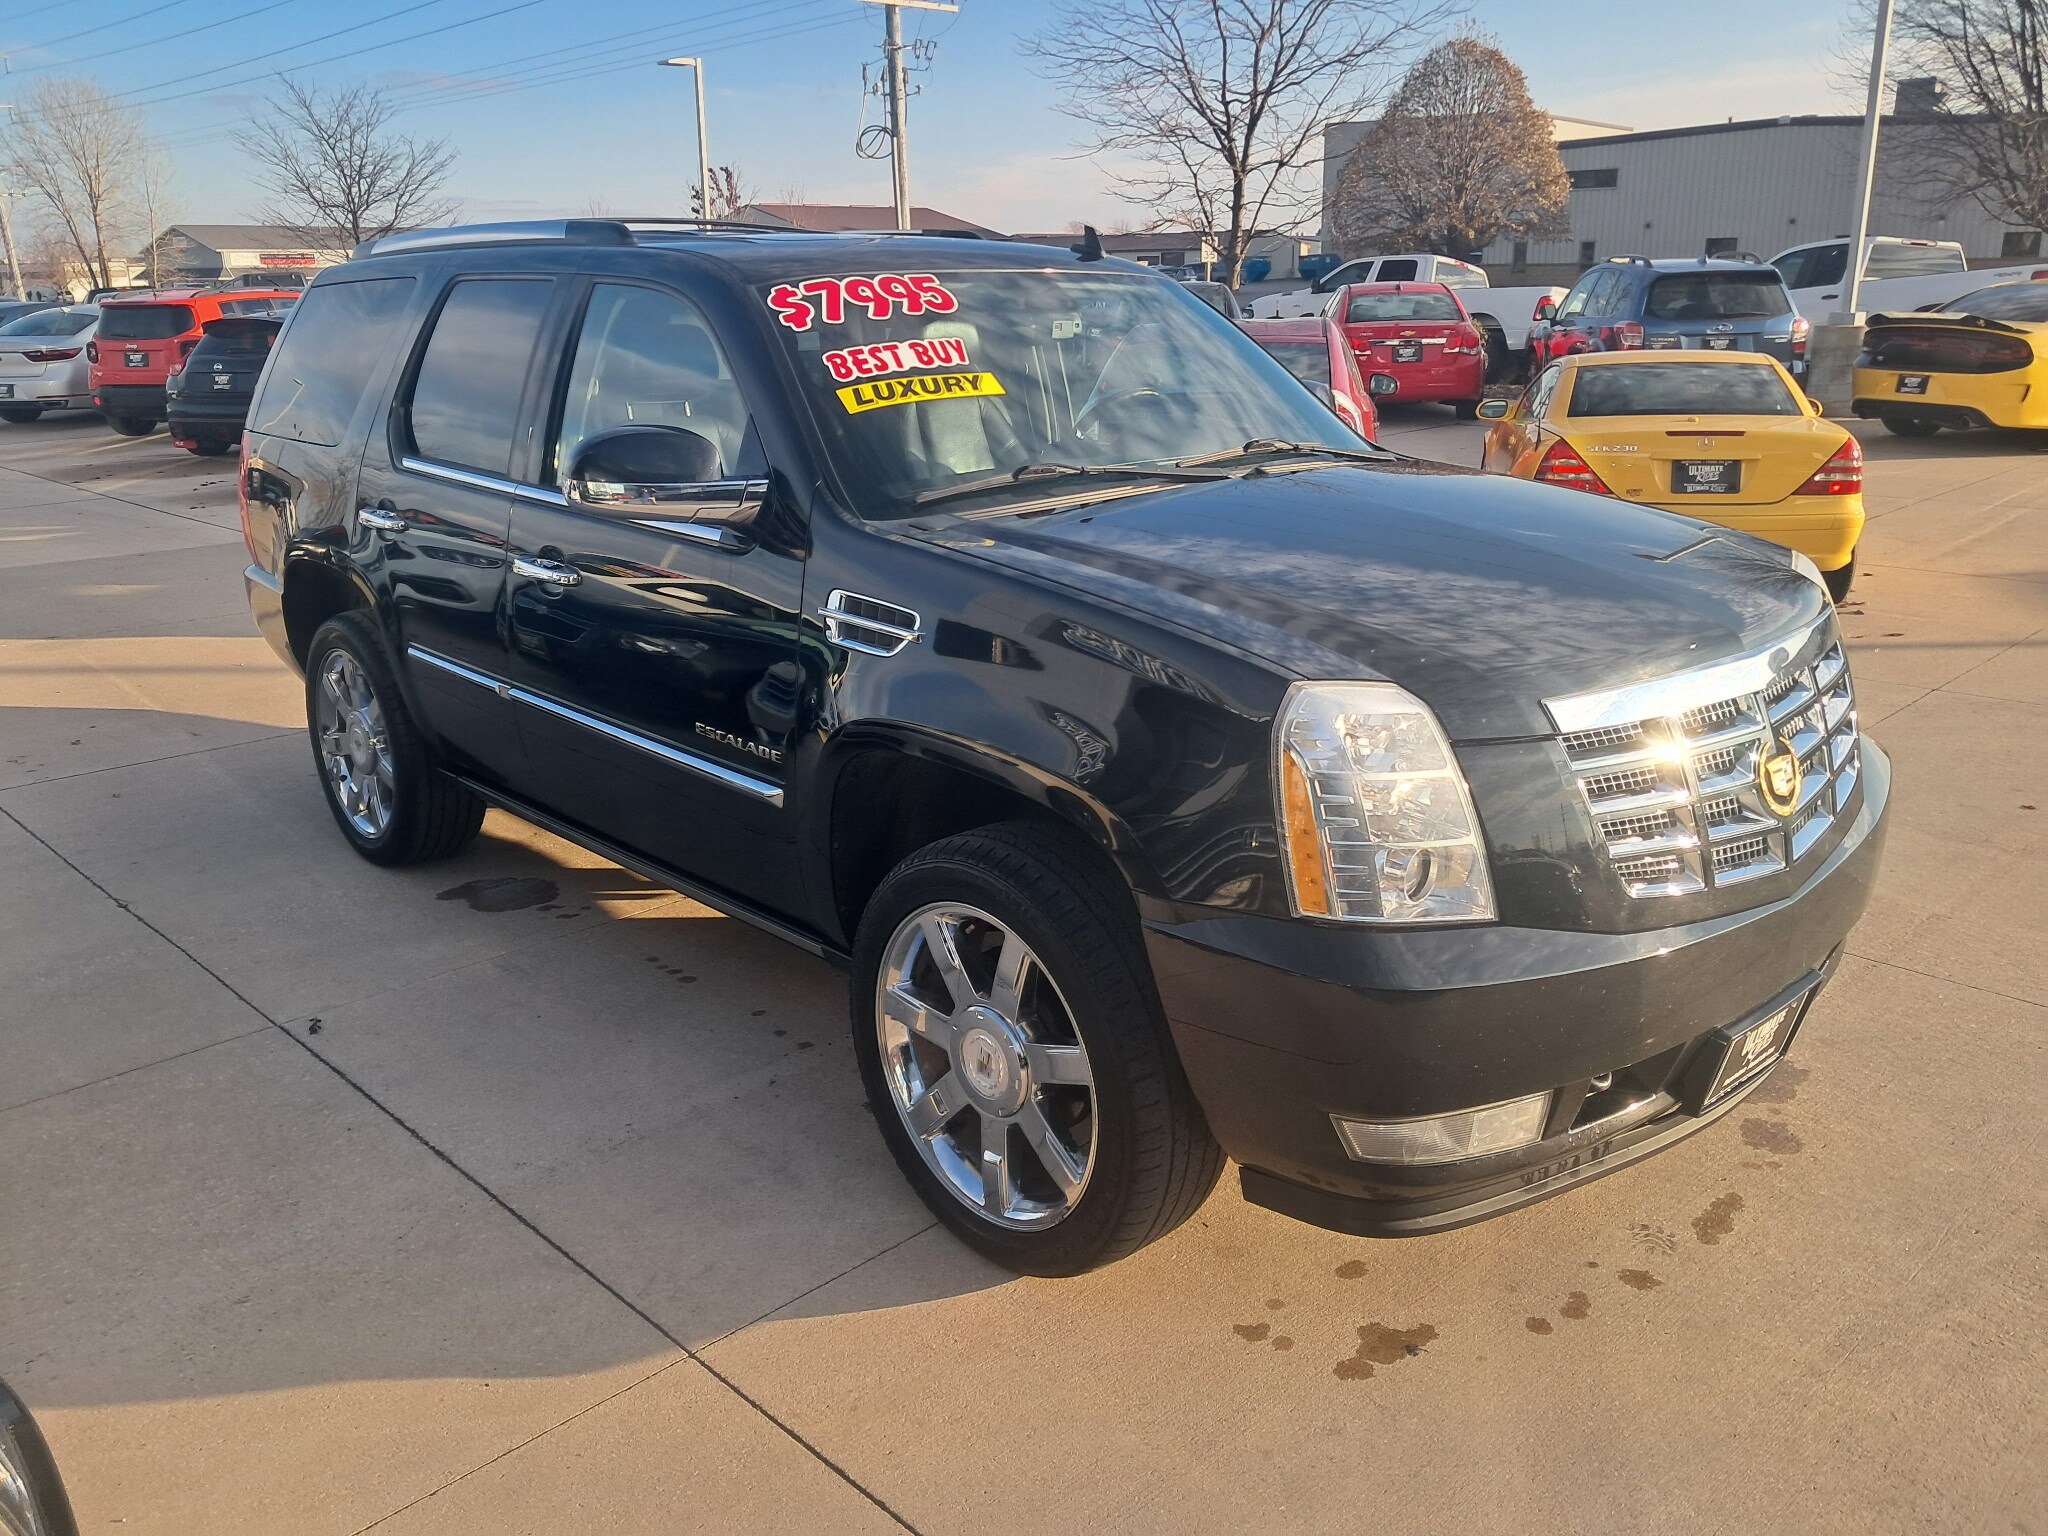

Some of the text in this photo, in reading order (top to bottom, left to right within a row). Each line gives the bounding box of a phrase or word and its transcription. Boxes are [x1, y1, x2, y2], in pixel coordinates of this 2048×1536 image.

[768, 274, 958, 331] $7995
[823, 338, 969, 381] BEST BUY
[851, 373, 982, 407] LUXURY
[1688, 465, 1724, 476] ULTIMATE
[695, 721, 782, 764] ESCALADE
